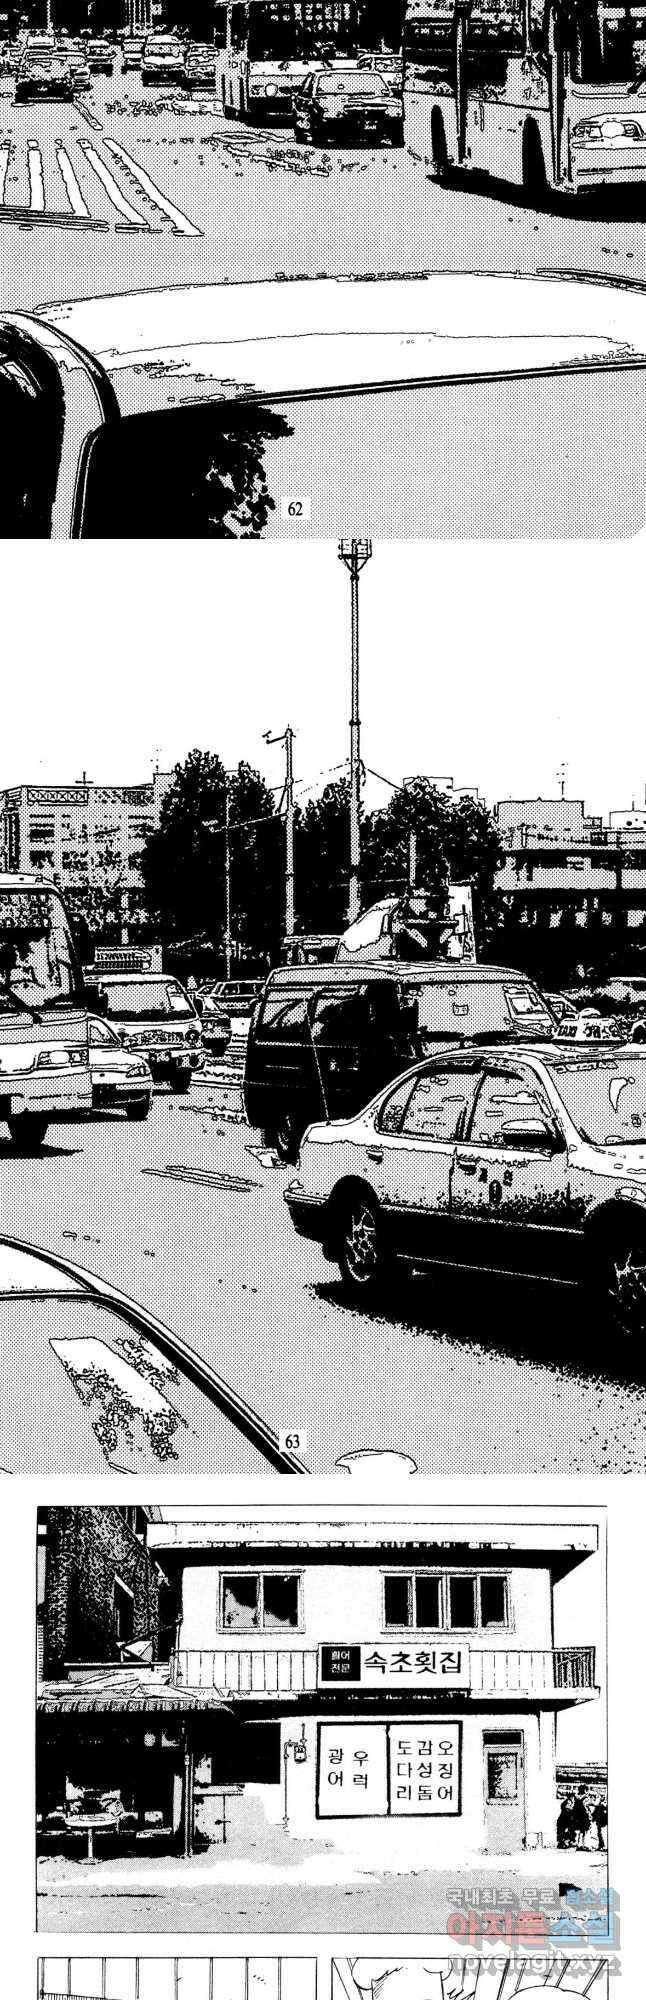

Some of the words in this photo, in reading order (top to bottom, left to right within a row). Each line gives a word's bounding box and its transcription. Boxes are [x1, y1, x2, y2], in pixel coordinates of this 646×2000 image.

[287, 501, 303, 516] 62
[285, 1434, 300, 1449] 63
[364, 1650, 462, 1675] 속초횟집
[327, 1748, 344, 1787] 광어
[352, 1750, 369, 1789] 우럭
[396, 1740, 413, 1801] 도다리
[416, 1740, 433, 1801] 감성돔
[437, 1740, 454, 1801] 오징어
